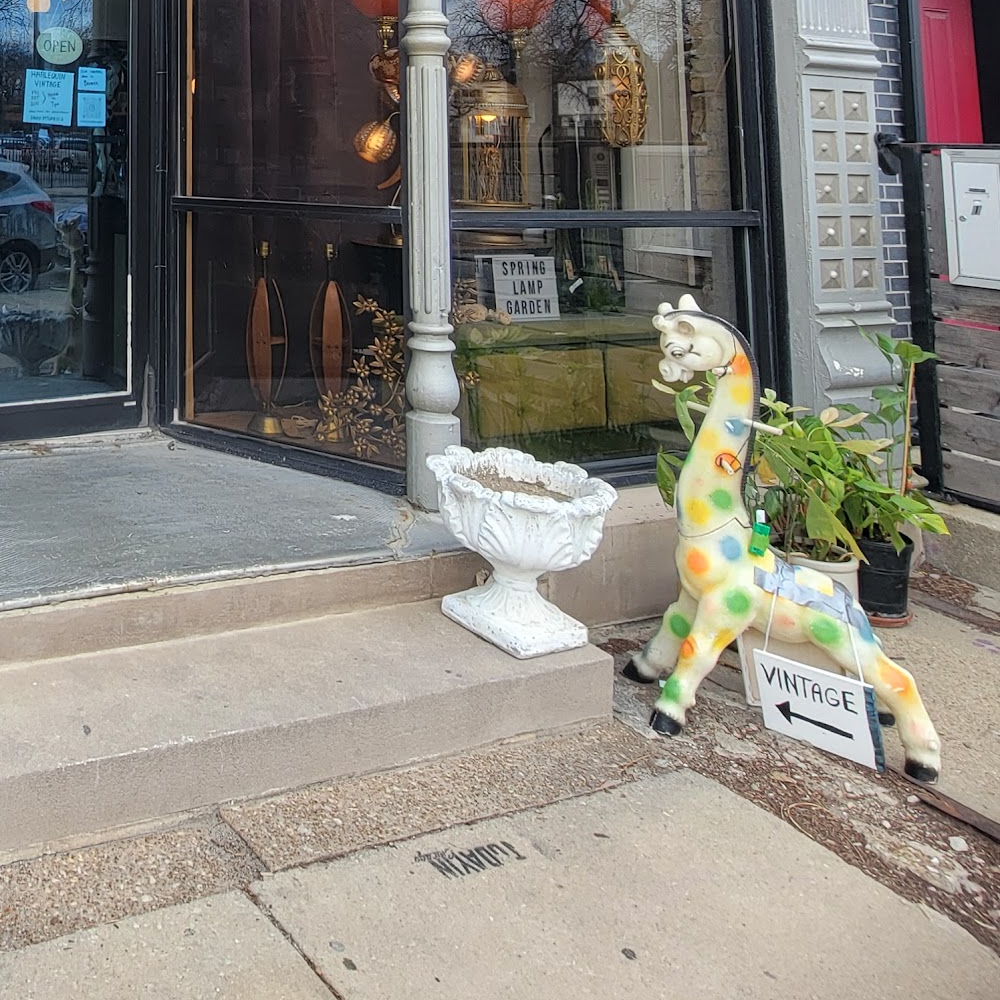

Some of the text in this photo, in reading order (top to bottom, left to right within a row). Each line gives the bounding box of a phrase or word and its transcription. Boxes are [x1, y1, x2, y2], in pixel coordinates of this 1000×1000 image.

[43, 39, 76, 54] OPEN
[31, 71, 66, 80] HARLEQUIN
[34, 80, 61, 88] VINTAGE
[502, 260, 546, 276] SPRING
[512, 280, 543, 295] LAMP
[506, 299, 551, 315] GARDEN
[760, 662, 858, 715] VINTAGE
